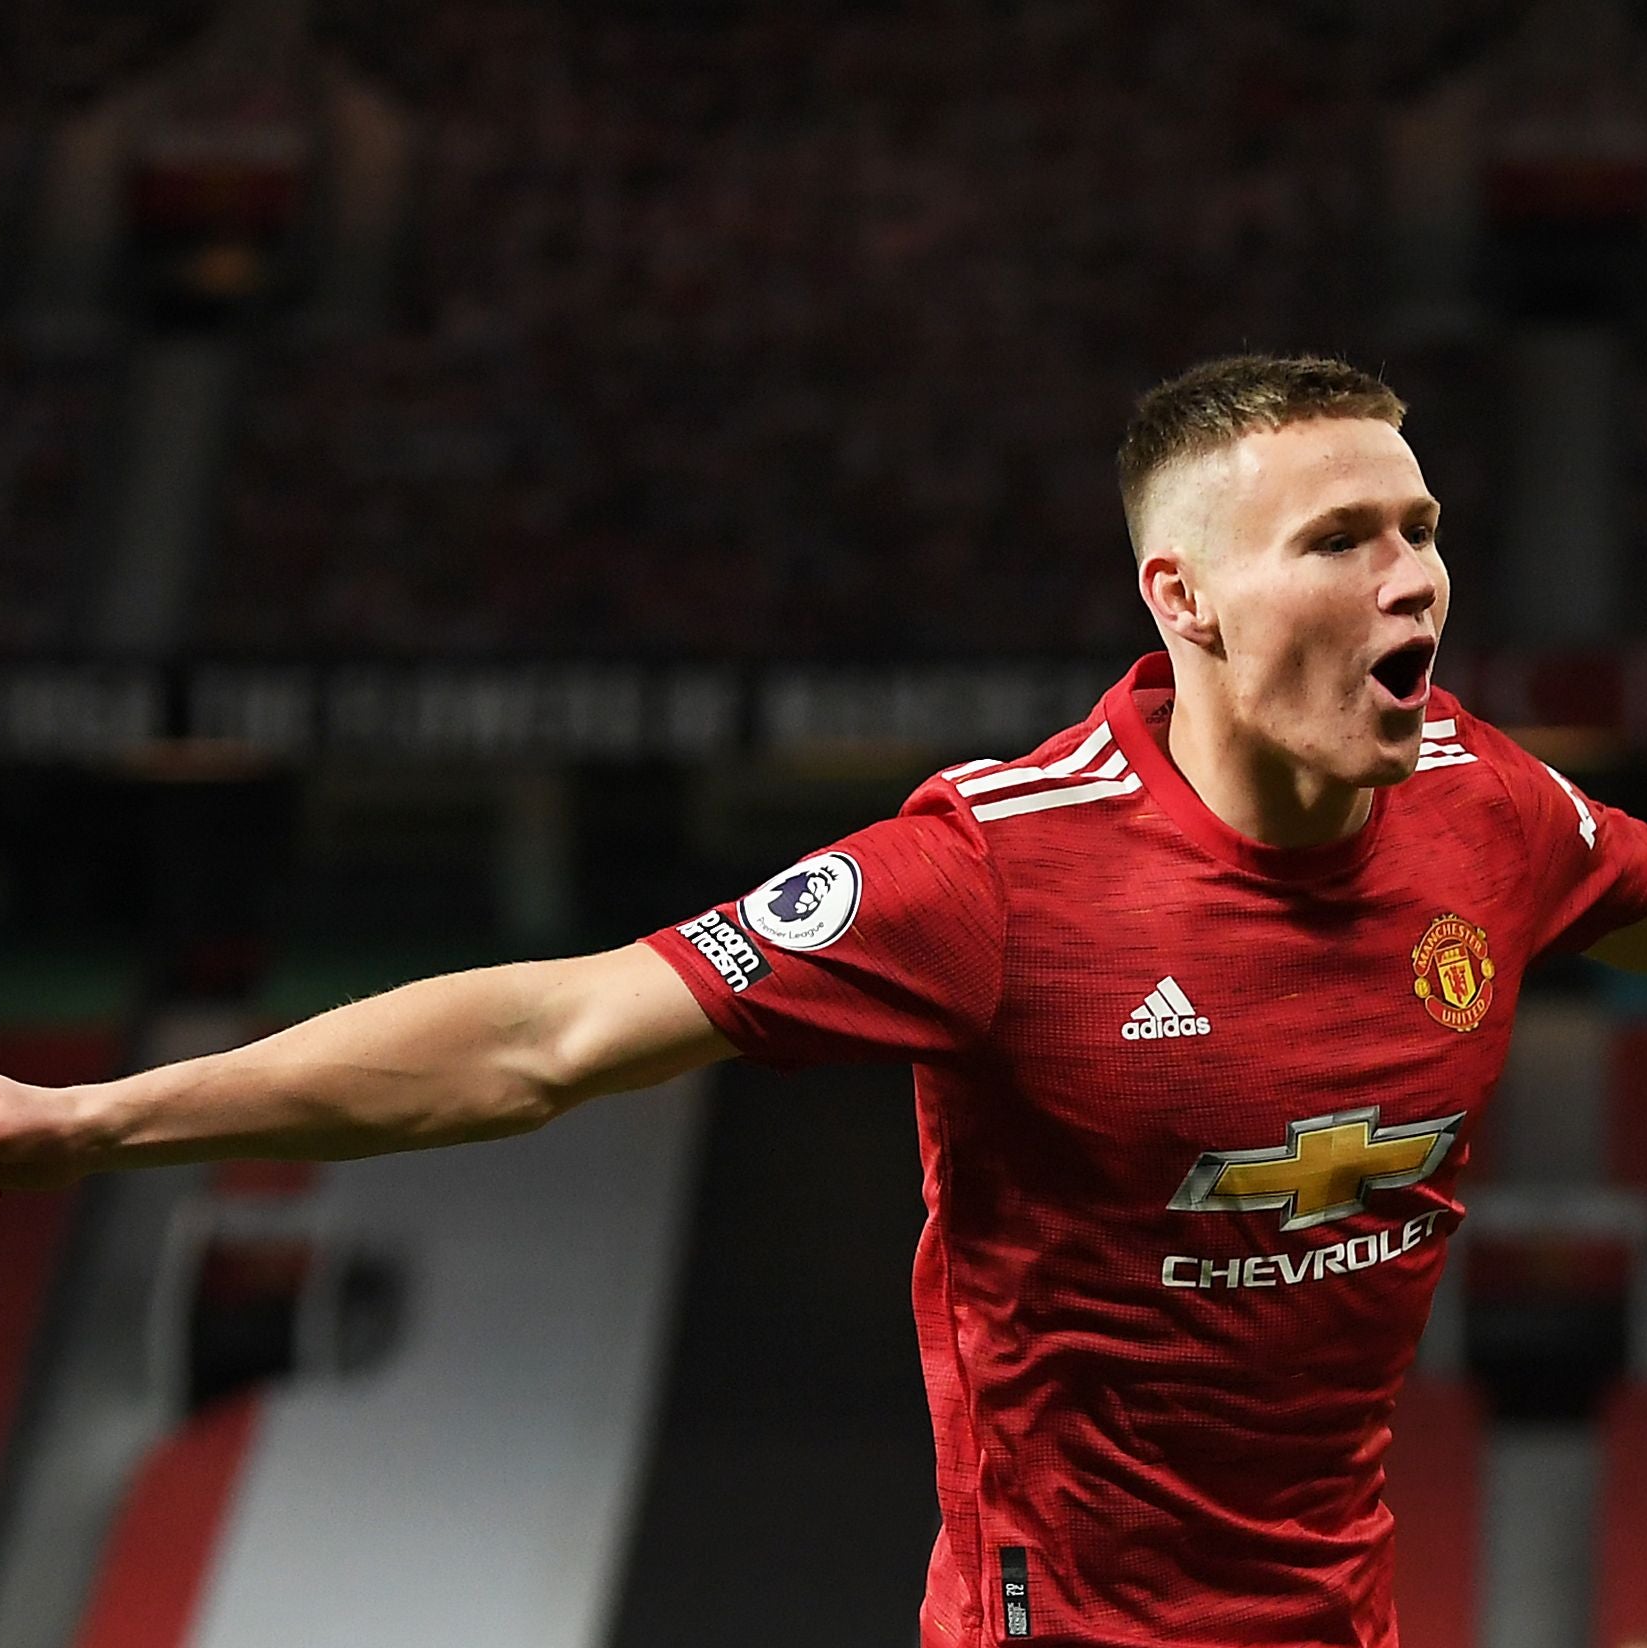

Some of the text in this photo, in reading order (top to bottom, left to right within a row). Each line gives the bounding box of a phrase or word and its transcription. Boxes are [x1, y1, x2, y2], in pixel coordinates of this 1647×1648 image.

[756, 915, 825, 940] Premier League
[1418, 923, 1483, 968] MANCHESTER
[1442, 998, 1486, 1025] UNITED
[1121, 1014, 1211, 1040] adidas
[1161, 1208, 1450, 1289] CHEVROLET
